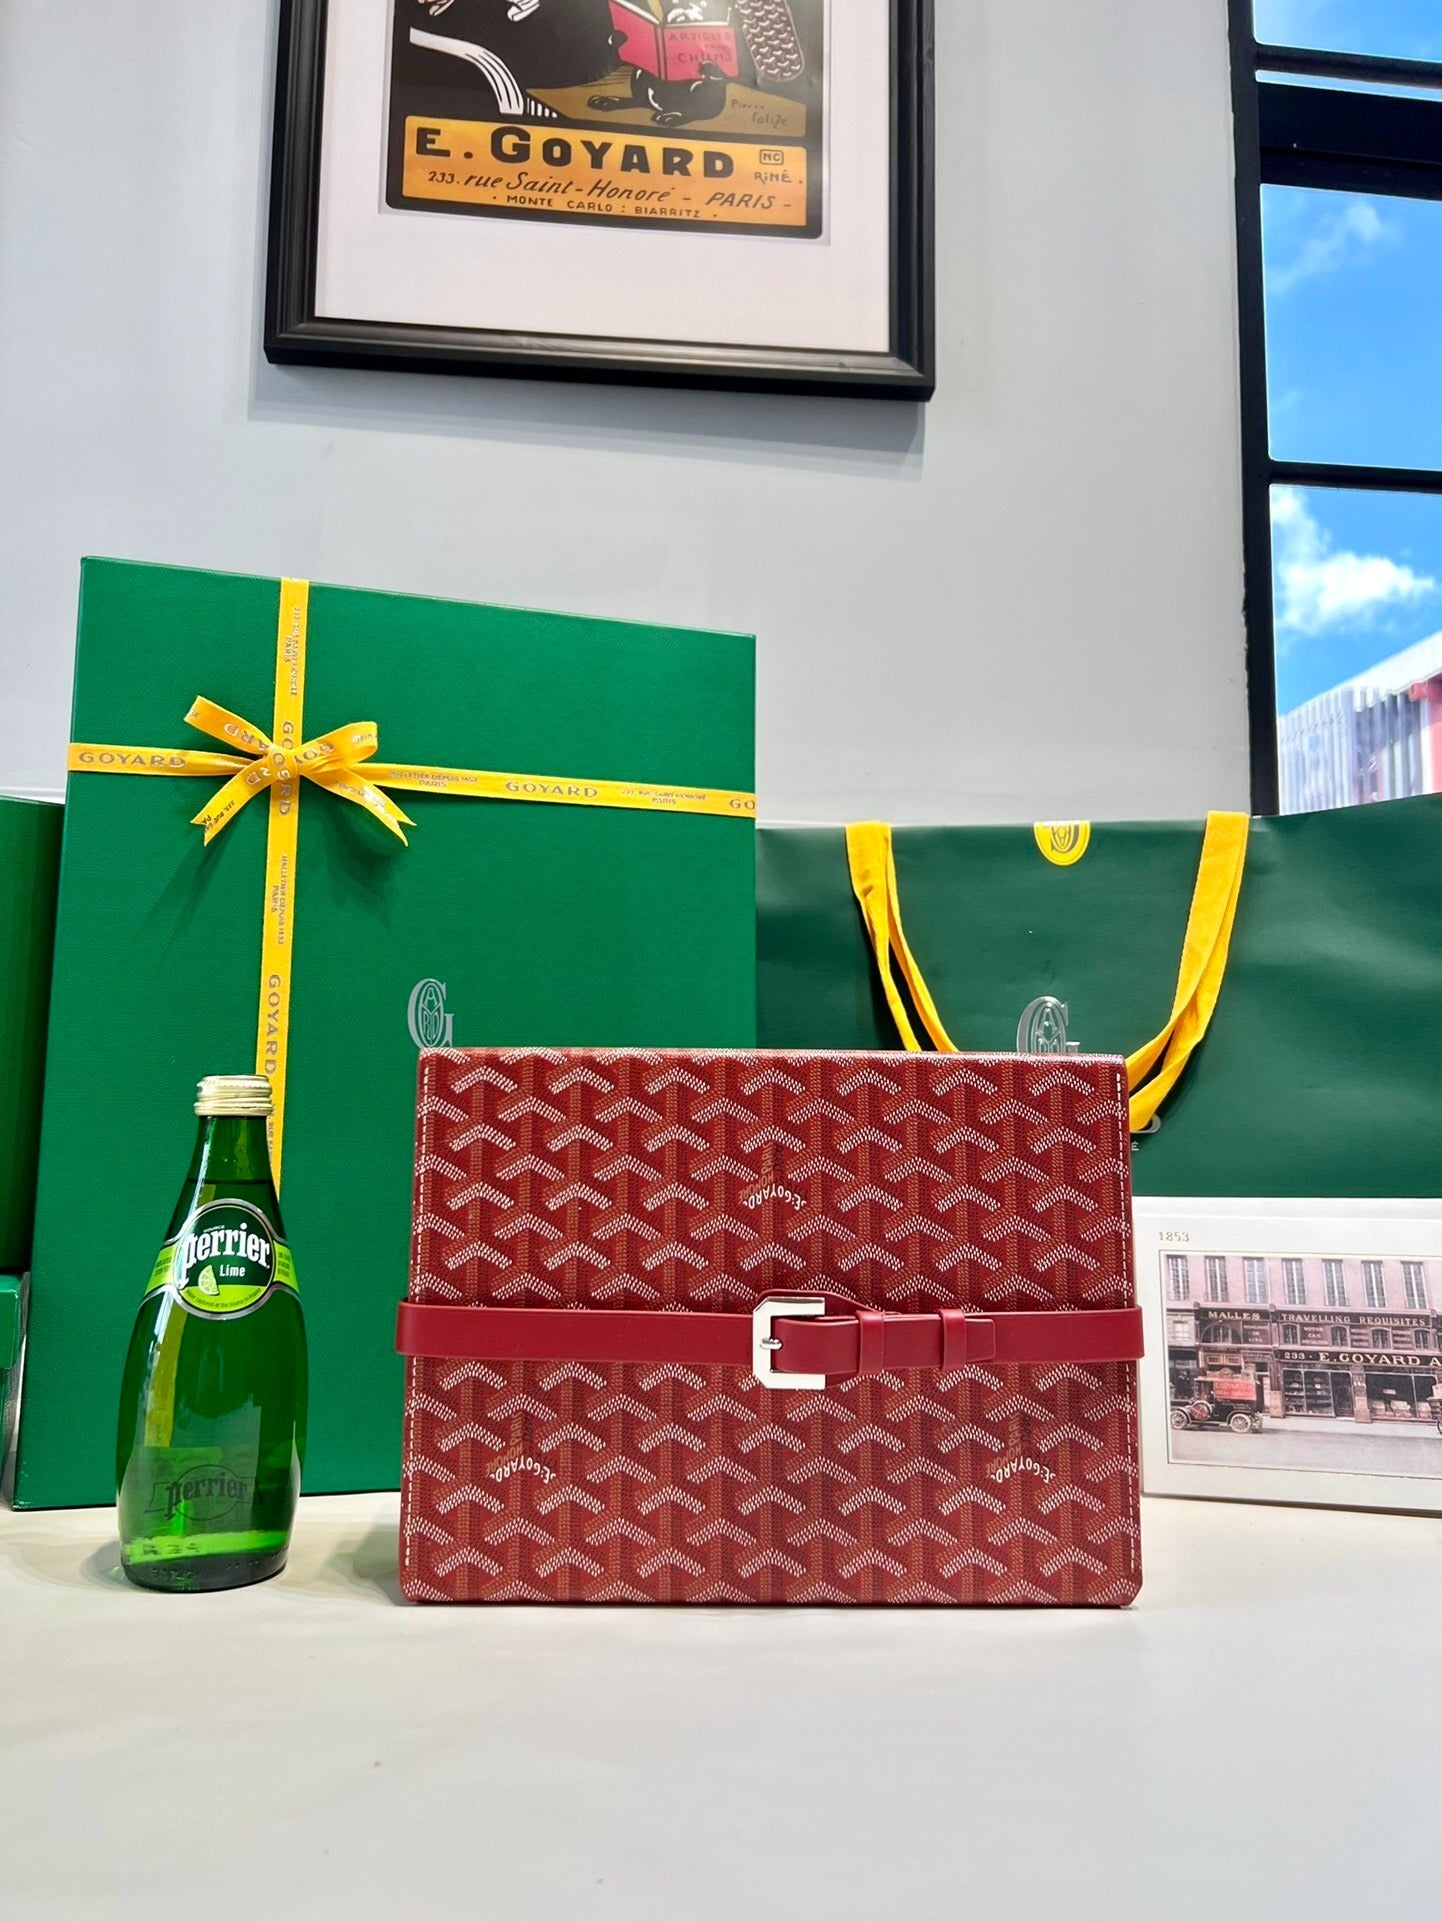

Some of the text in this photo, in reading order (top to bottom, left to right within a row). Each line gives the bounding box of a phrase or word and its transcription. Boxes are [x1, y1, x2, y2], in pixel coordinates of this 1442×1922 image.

[490, 125, 735, 179] GOYARD
[463, 174, 504, 189] rue
[704, 191, 776, 210] PARIS
[506, 194, 700, 219] MONTE CARLO BIARRITZ
[78, 750, 187, 769] GOYARD
[505, 780, 599, 798] GOYARD
[264, 974, 281, 1075] GOYARD
[1158, 1231, 1190, 1242] 1853
[219, 1264, 246, 1277] Lime
[1208, 1310, 1426, 1327] MALLES TRAVELLING REQUISITES
